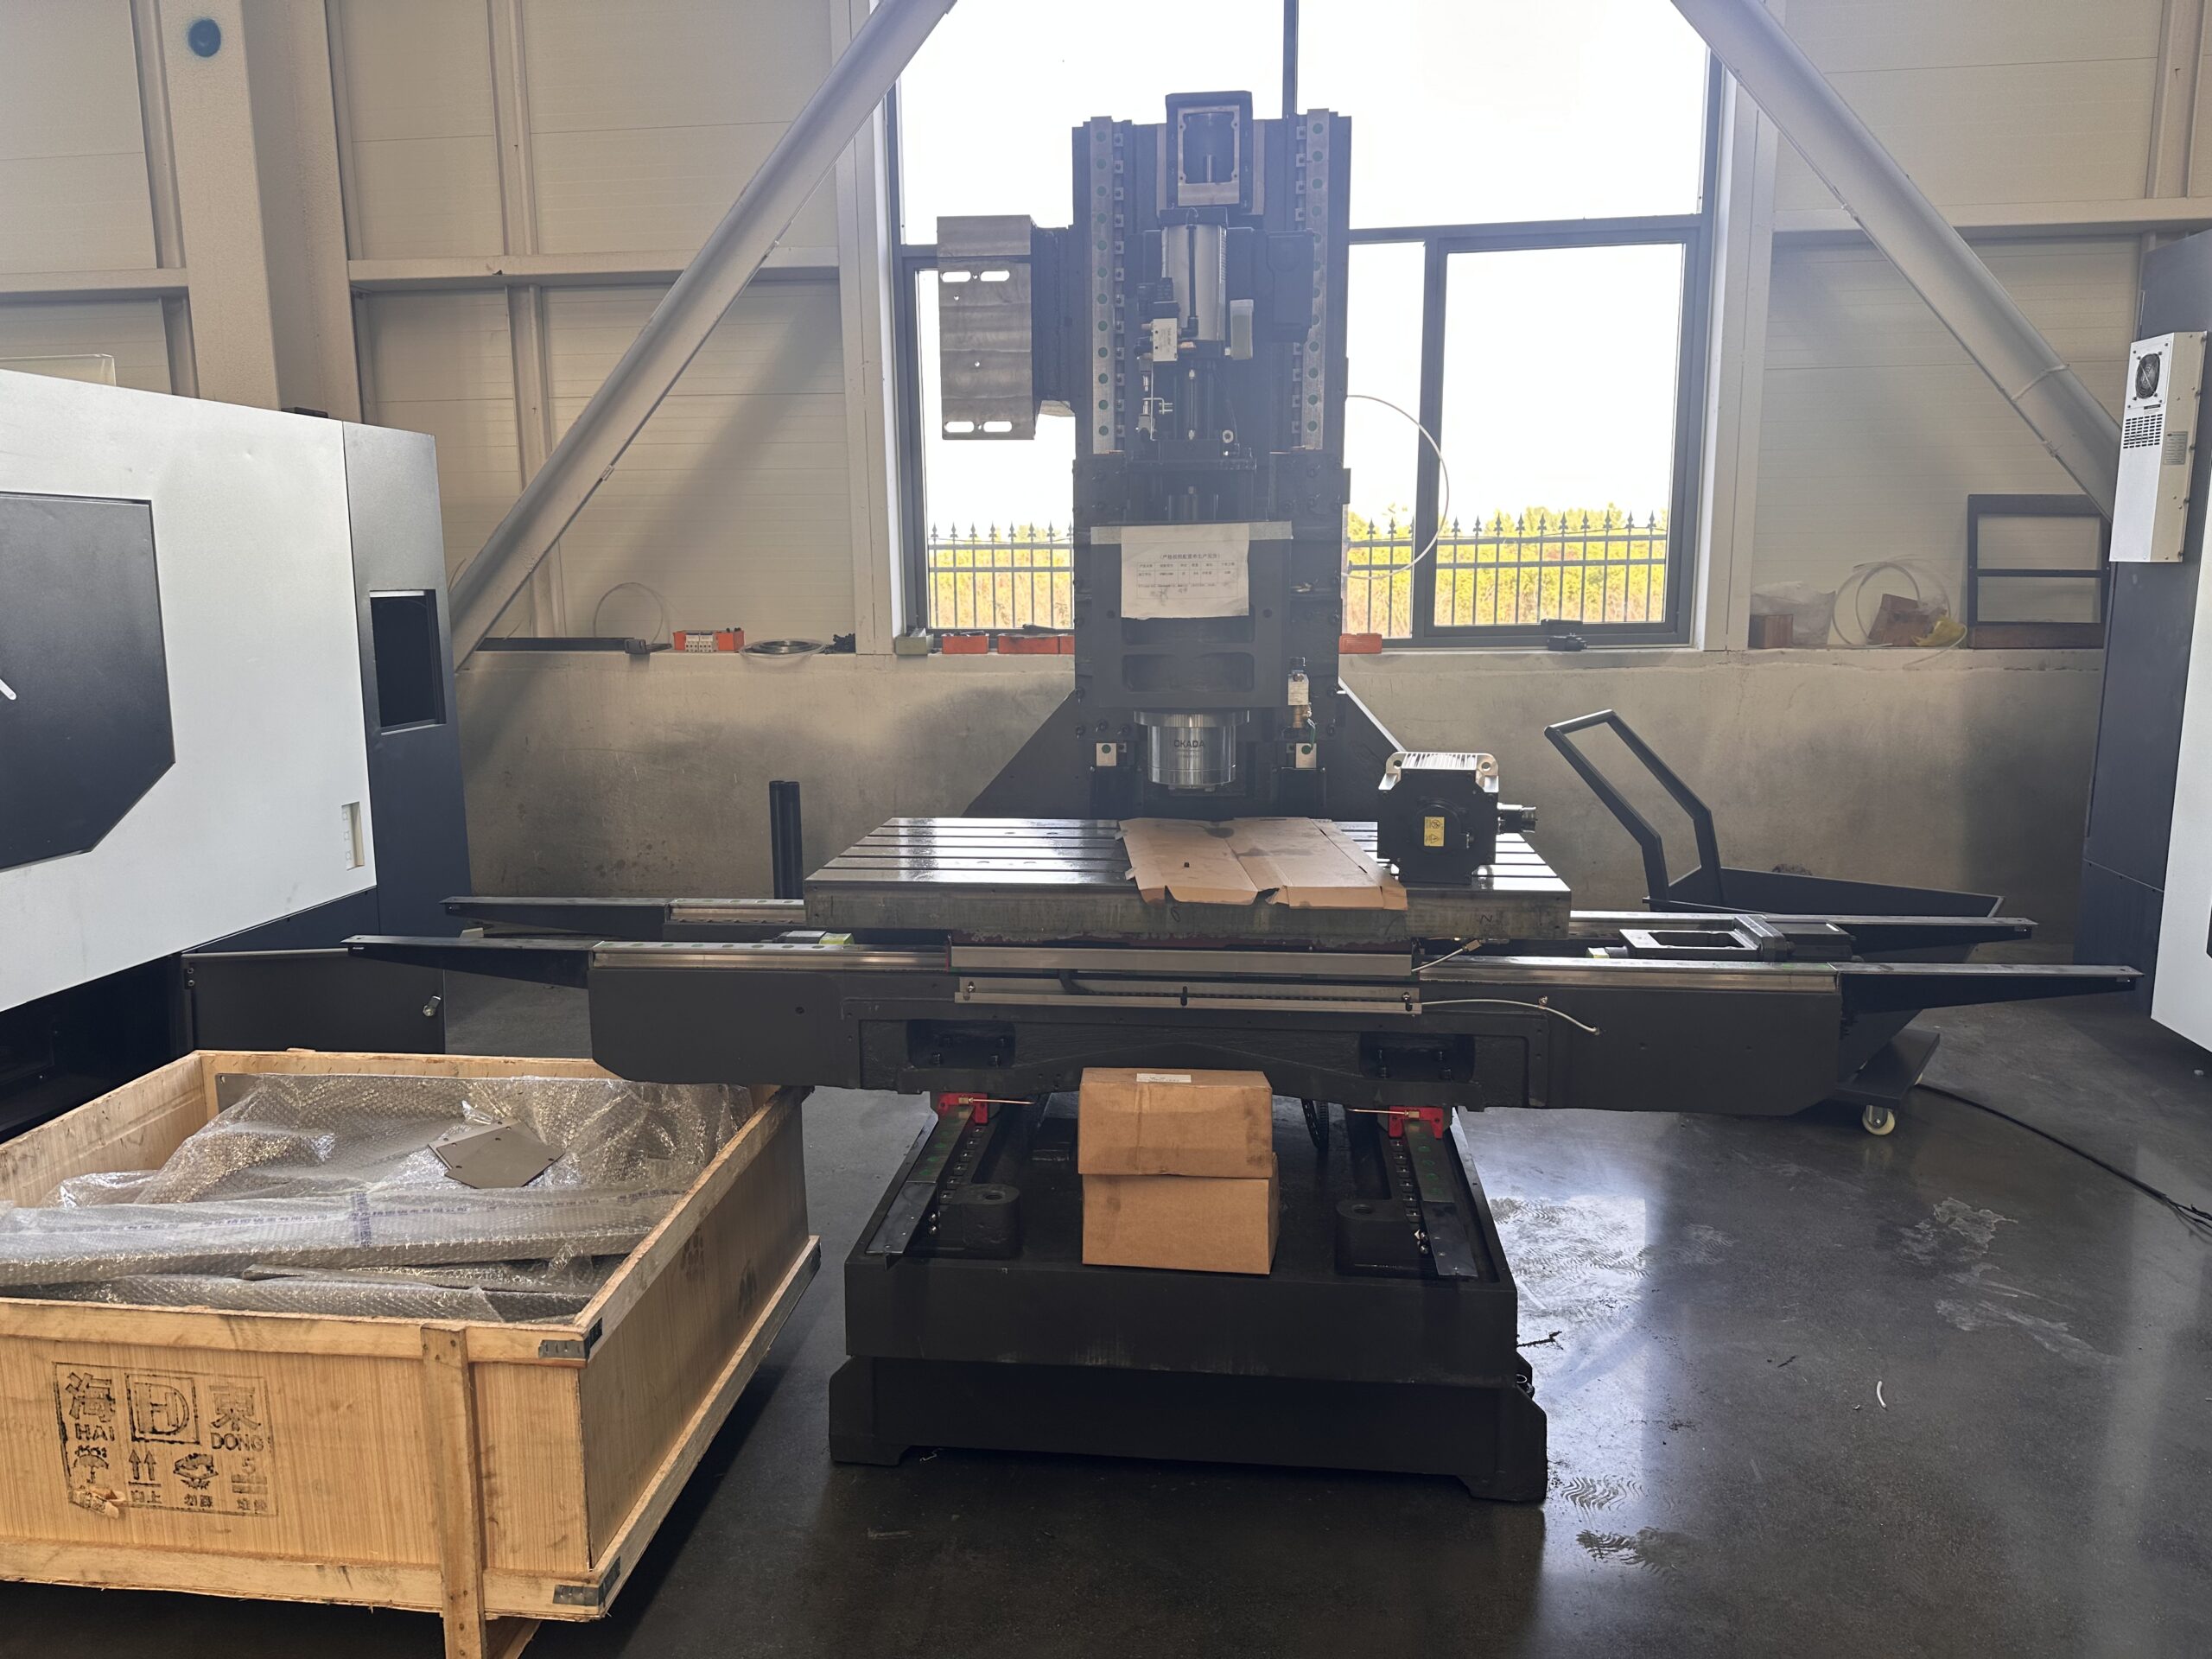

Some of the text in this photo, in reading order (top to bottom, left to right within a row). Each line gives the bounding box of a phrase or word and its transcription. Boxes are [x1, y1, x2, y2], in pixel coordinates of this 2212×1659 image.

[1173, 739, 1205, 748] OKADA
[66, 1371, 116, 1423] 海
[209, 1384, 261, 1432] 東
[75, 1423, 115, 1441] HAI
[210, 1432, 264, 1452] DONG
[242, 1457, 257, 1476] 5
[130, 1490, 162, 1504] 向上
